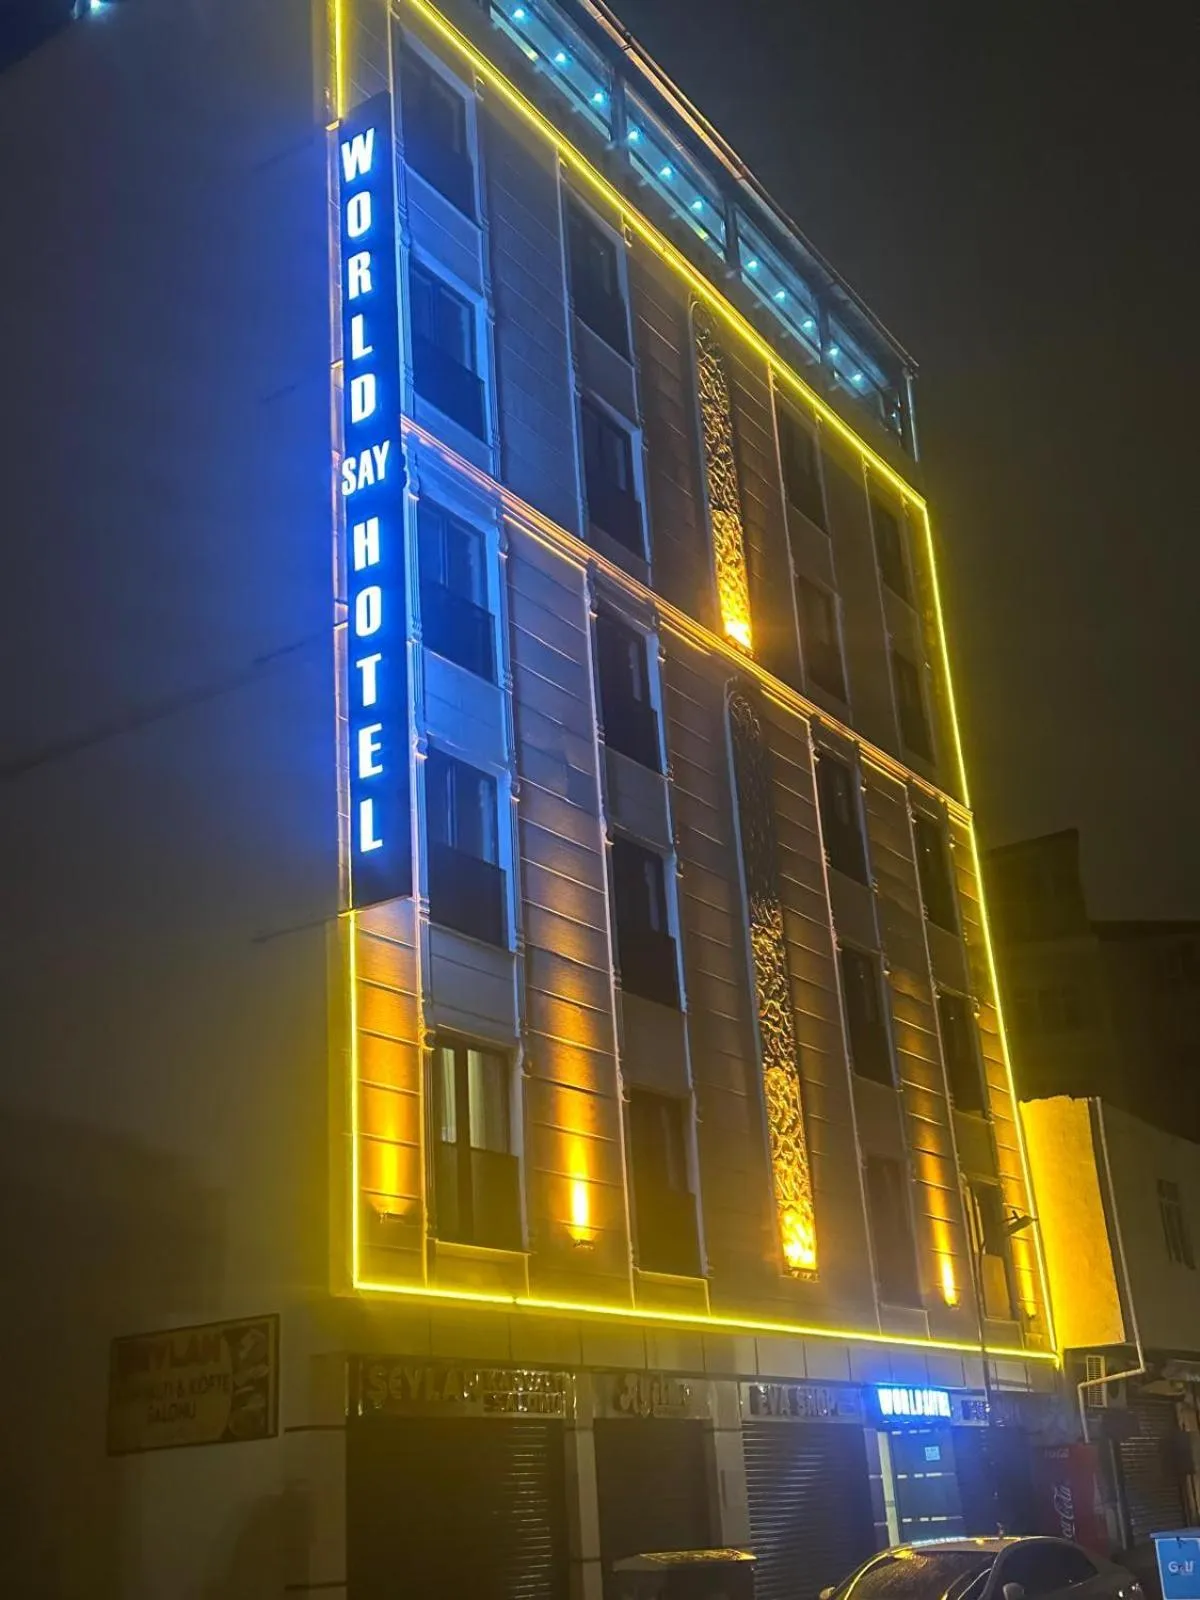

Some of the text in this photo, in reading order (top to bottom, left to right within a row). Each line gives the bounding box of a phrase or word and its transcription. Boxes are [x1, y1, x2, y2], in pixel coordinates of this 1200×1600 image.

[341, 127, 377, 425] WORLD
[342, 439, 390, 497] SAY
[353, 515, 385, 855] HOTEL
